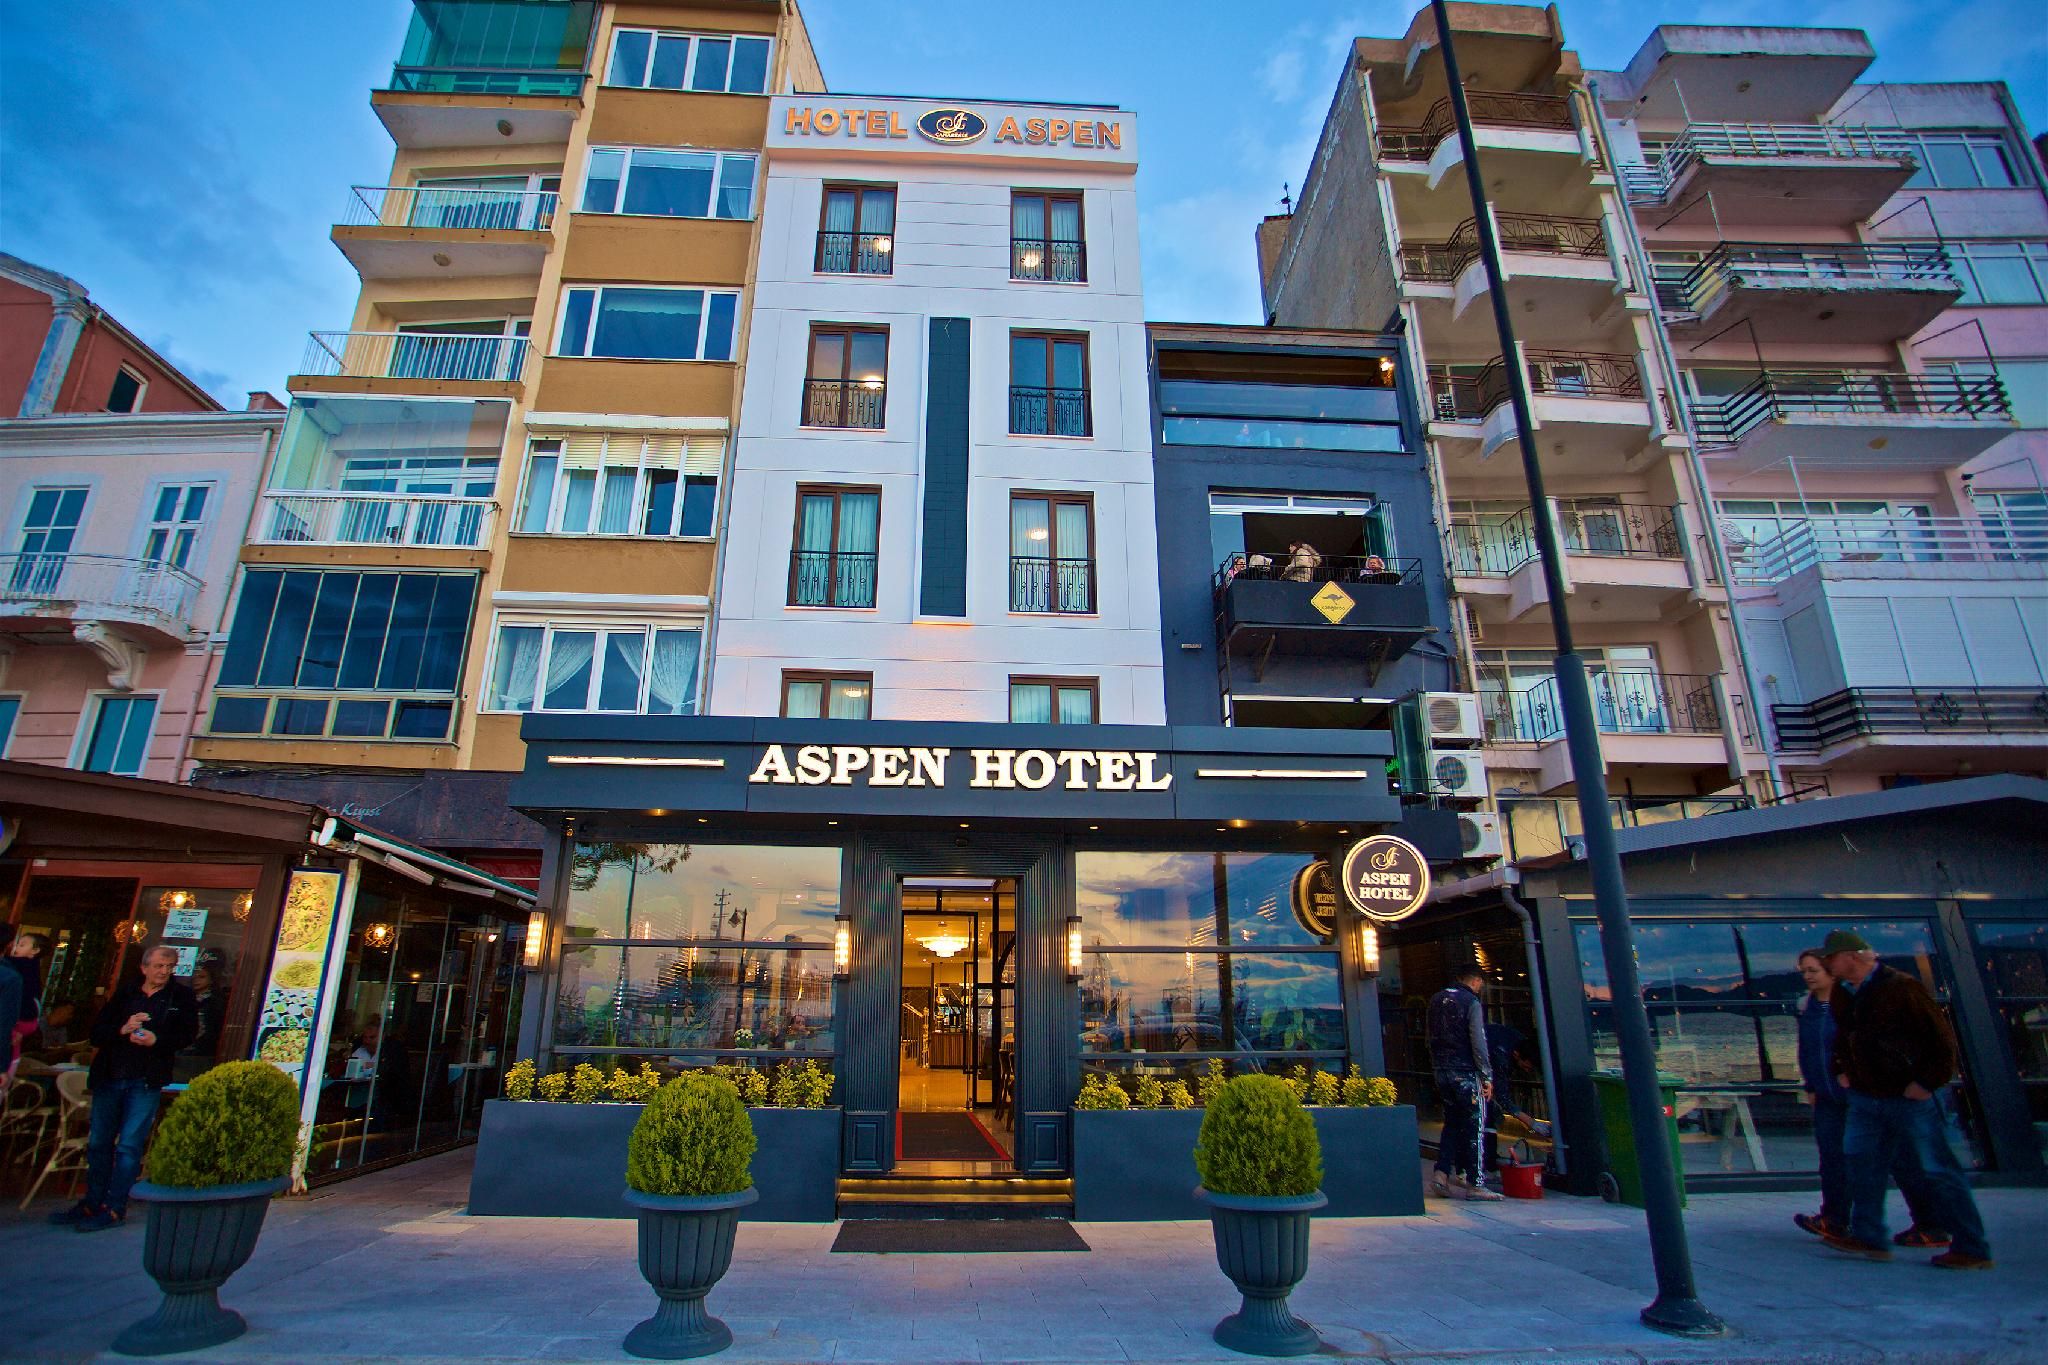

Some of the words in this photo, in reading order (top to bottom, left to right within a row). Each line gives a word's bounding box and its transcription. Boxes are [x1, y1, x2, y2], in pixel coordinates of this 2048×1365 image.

[785, 107, 908, 138] HOTEL
[994, 116, 1121, 149] ASPEN
[749, 744, 951, 788] ASPEN
[970, 749, 1174, 791] HOTEL
[1360, 871, 1411, 886] ASPEN
[1359, 886, 1413, 900] HOTEL
